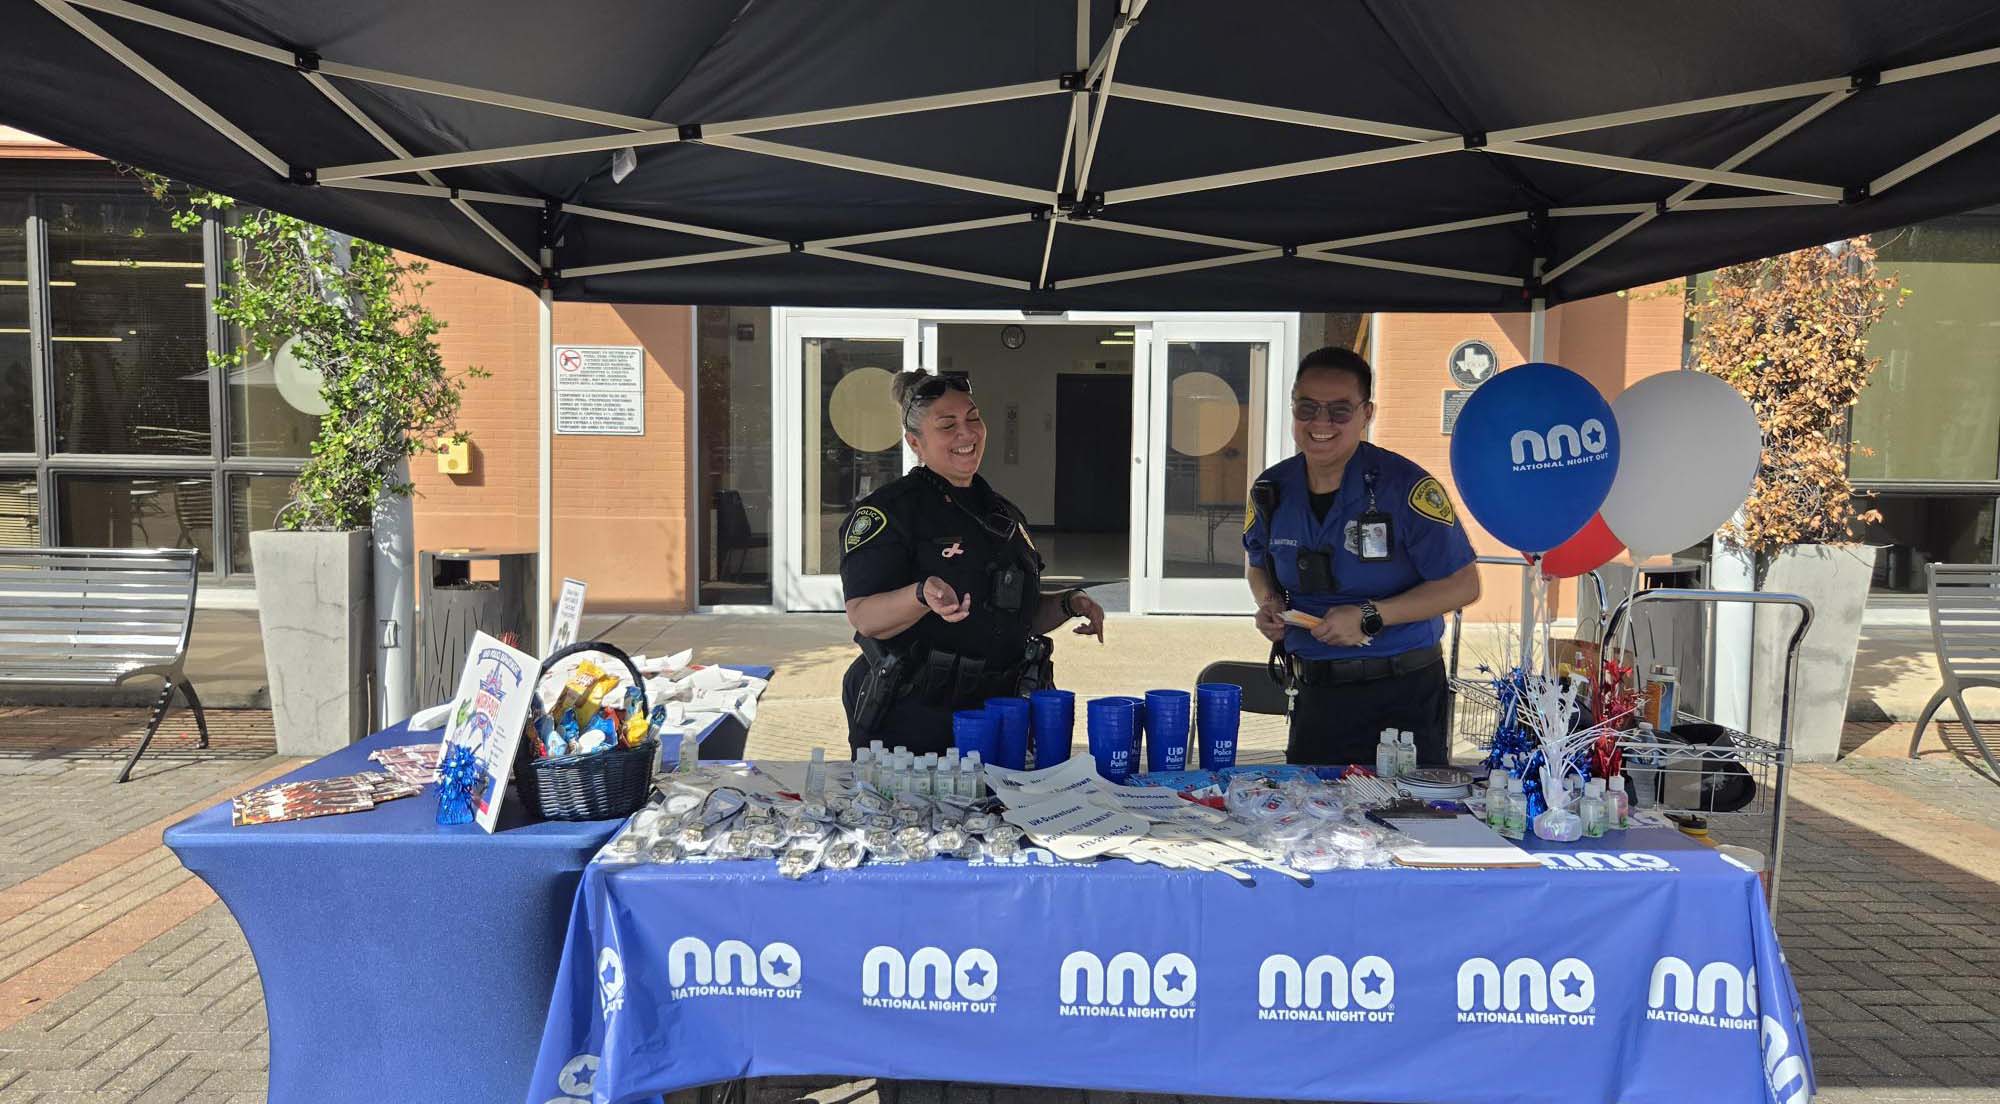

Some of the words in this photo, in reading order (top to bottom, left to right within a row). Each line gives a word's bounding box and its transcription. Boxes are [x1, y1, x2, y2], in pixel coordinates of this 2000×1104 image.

[1512, 461, 1564, 472] NATIONAL
[1567, 456, 1594, 467] NIGHT
[1595, 452, 1609, 462] OUT
[856, 509, 881, 521] POLICE
[1165, 755, 1184, 763] Police
[1213, 748, 1232, 756] Police
[1110, 760, 1128, 768] Police
[672, 986, 734, 1000] NATIONAL
[737, 986, 775, 999] NIGHT
[776, 988, 802, 999] OUT
[863, 997, 927, 1010] NATIONAL
[929, 1000, 968, 1012] NIGHT
[970, 1002, 997, 1013] OUT
[1060, 1005, 1125, 1017] NATIONAL
[1127, 1007, 1167, 1019] NIGHT
[1169, 1008, 1196, 1019] OUT
[1259, 1009, 1324, 1021] NATIONAL
[1326, 1010, 1365, 1022] NIGHT
[1368, 1011, 1394, 1022] OUT
[1457, 1012, 1523, 1024] NATIONAL
[1525, 1013, 1567, 1025] NIGHT
[1568, 1014, 1596, 1026] OUT
[1646, 1009, 1717, 1027] NATIONAL
[1720, 1018, 1759, 1030] NIGHT
